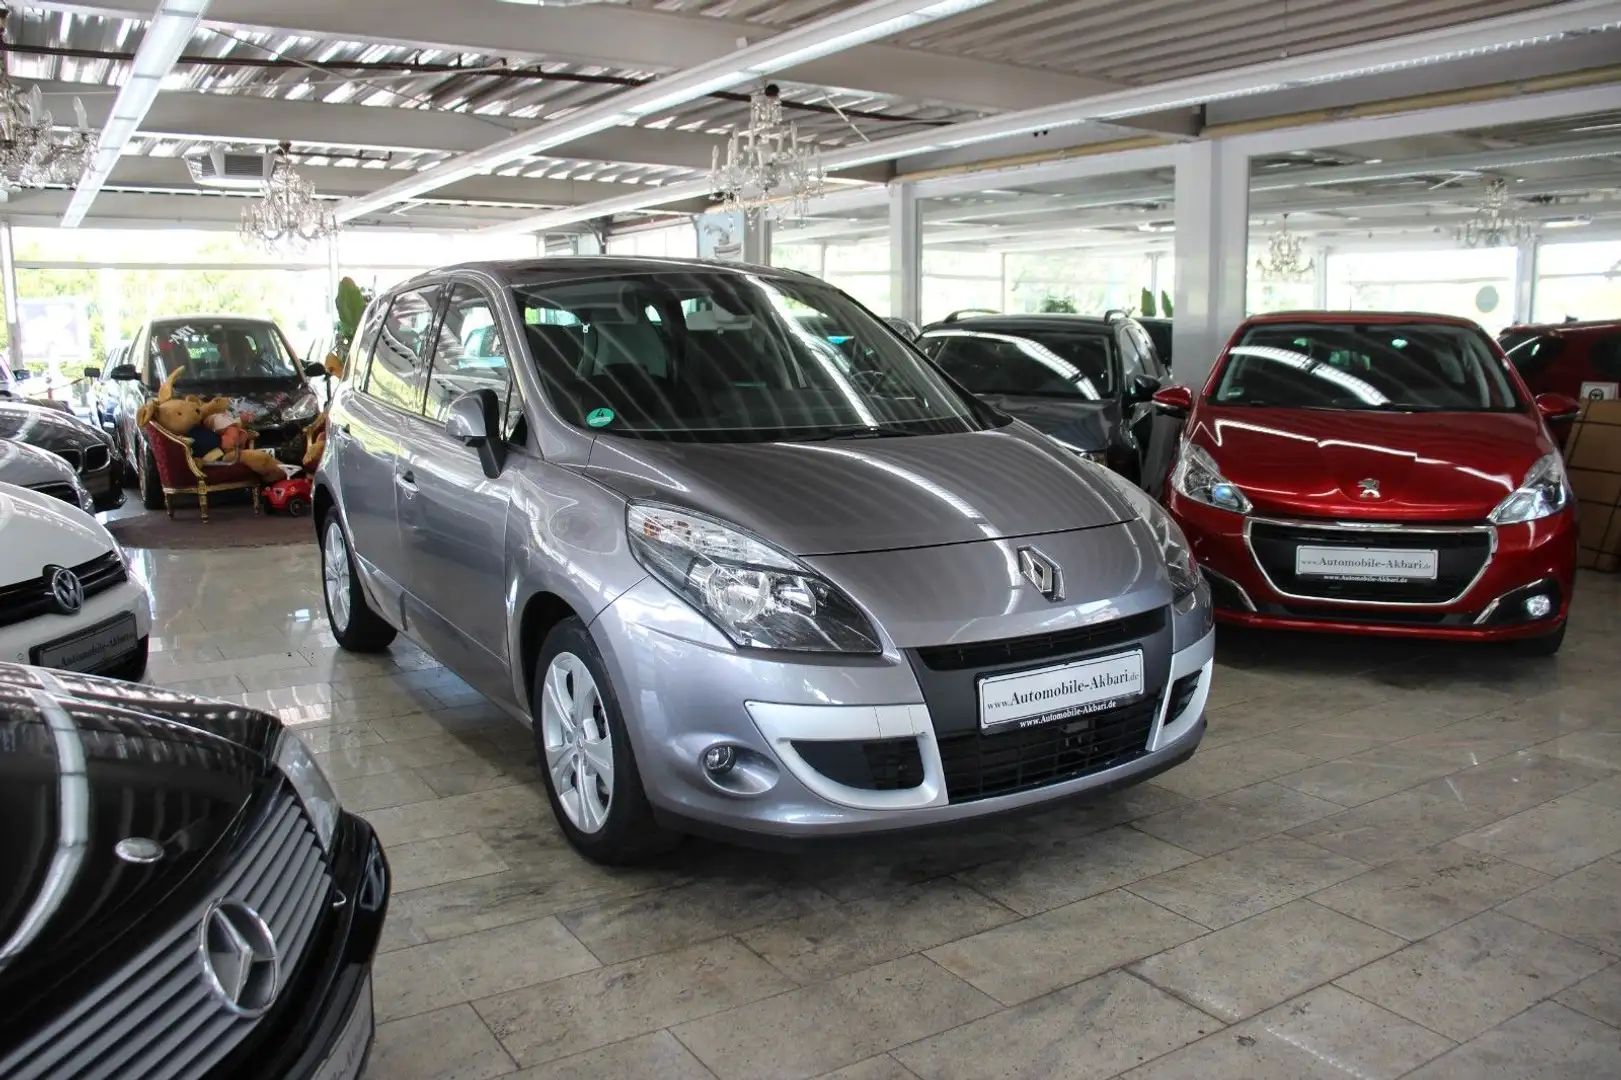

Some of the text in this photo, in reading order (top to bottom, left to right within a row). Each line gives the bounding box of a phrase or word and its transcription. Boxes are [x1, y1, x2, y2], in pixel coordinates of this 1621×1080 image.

[1301, 556, 1431, 570] www.Automobile-Akbari.de
[1323, 574, 1408, 583] www.Automobile-Akbari.de
[987, 669, 1139, 709] www.Automobile-Akbari.de
[1019, 700, 1117, 728] www.Automobile-Akbari.de
